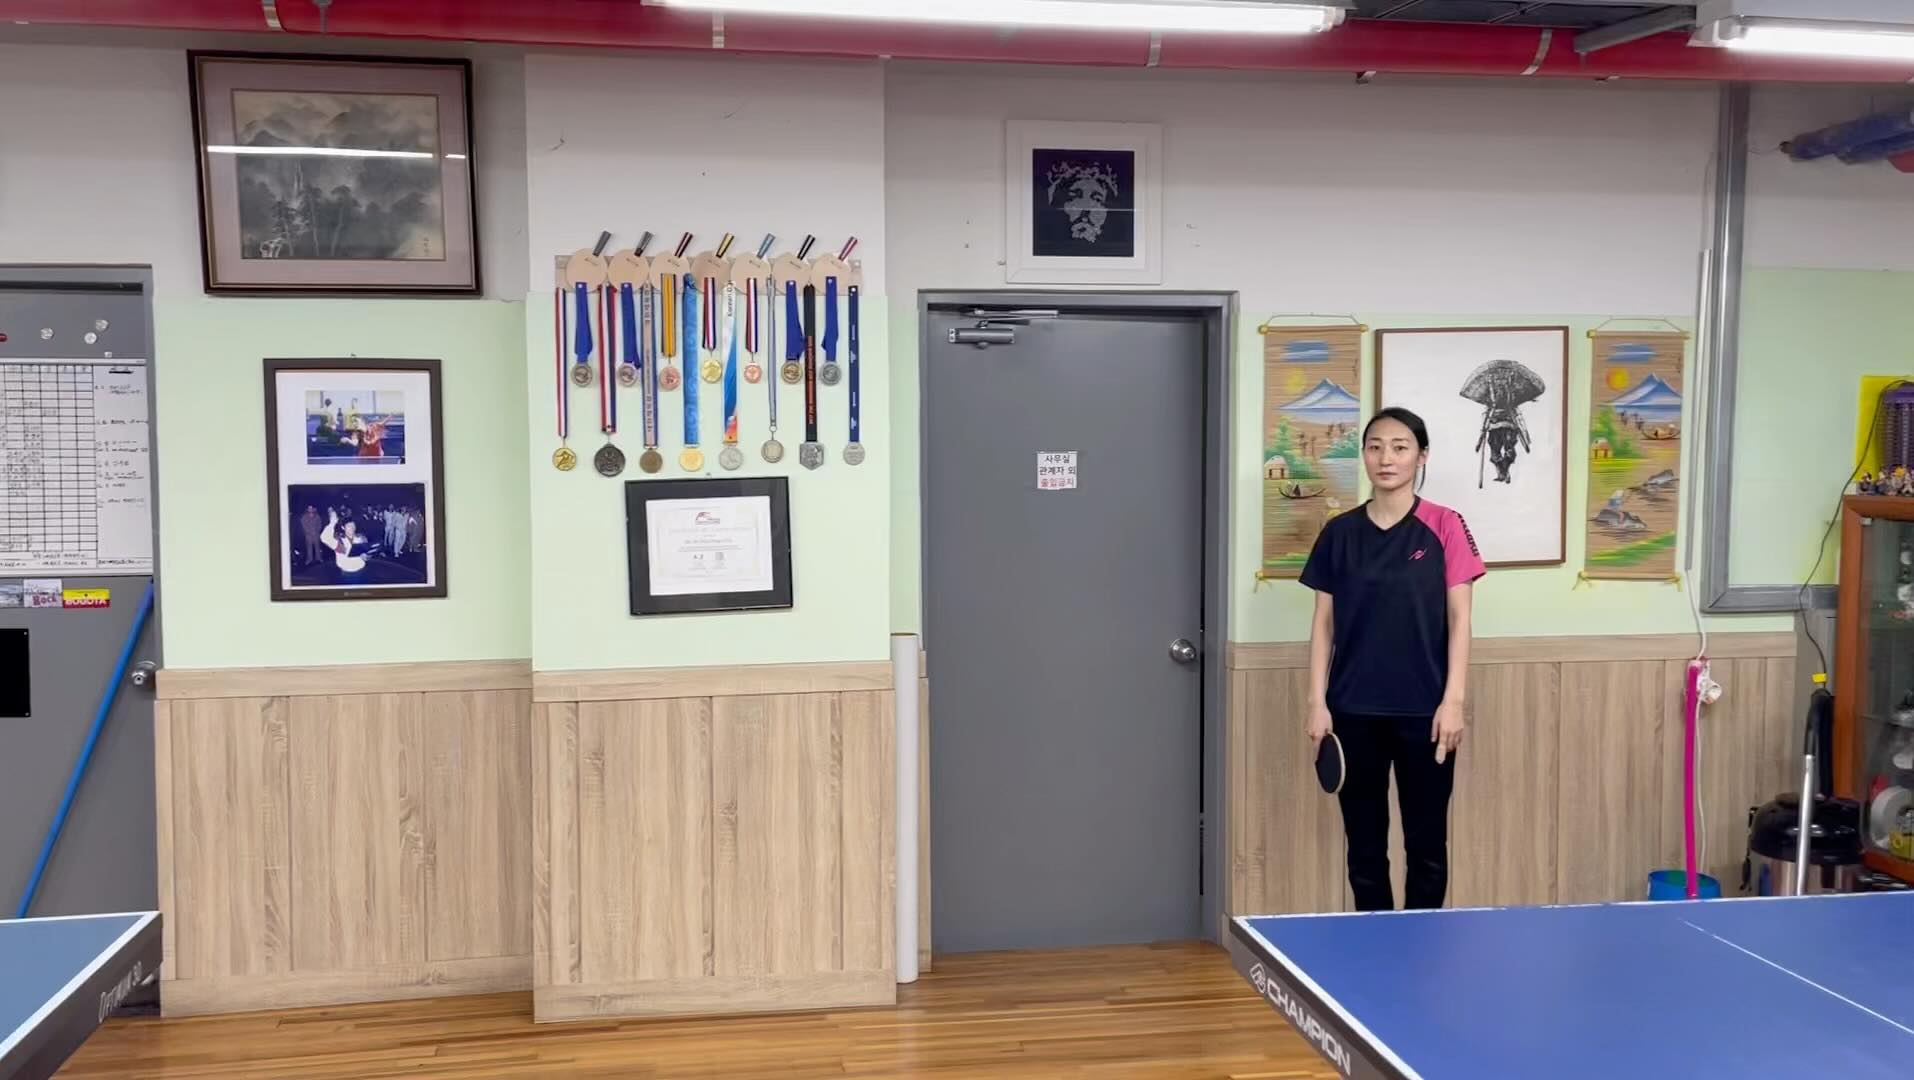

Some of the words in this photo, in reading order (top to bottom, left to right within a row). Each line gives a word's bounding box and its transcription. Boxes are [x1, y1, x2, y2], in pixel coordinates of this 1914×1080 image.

[1040, 466, 1065, 476] 관계자
[1067, 466, 1076, 475] 외
[1041, 478, 1073, 487] 출입금지
[1267, 977, 1351, 1076] CHAMPION
